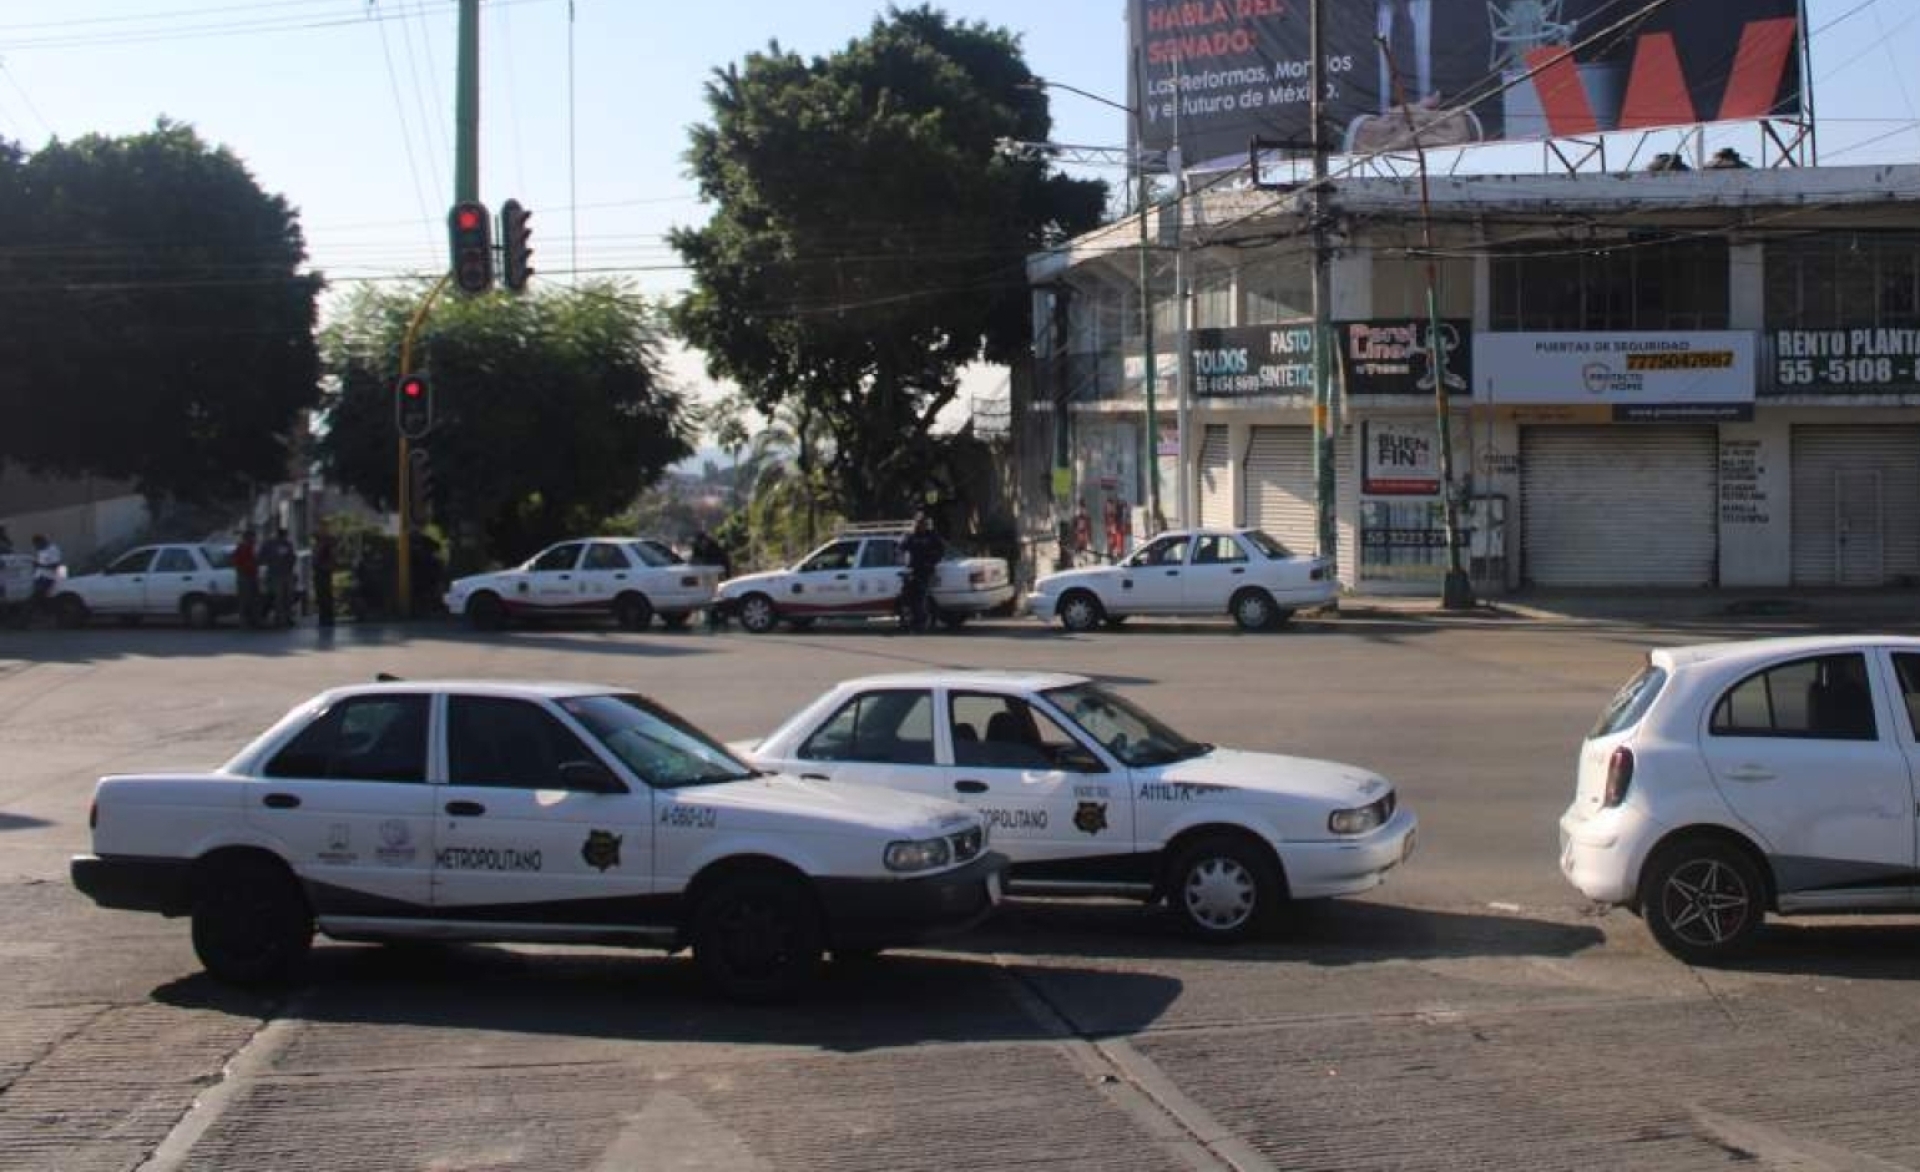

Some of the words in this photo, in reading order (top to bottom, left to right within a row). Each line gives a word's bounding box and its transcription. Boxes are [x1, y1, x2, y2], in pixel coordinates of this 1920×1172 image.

[1148, 2, 1229, 31] HABLA
[1237, 0, 1285, 18] DEL
[1148, 78, 1176, 96] Las
[1180, 65, 1270, 93] Reformas,
[1275, 55, 1354, 78] Morlos
[1148, 103, 1158, 123] y
[1183, 95, 1236, 116] futuro
[1239, 89, 1264, 110] de
[1268, 81, 1340, 105] Méxio.
[1270, 329, 1311, 355] PASTO
[1535, 341, 1590, 352] PUERTAS
[1595, 341, 1611, 351] DE
[1613, 340, 1691, 351] SEGURIDAD
[1778, 329, 1846, 357] RENTO
[1192, 347, 1248, 375] TOLDOS
[1779, 359, 1813, 385] 55
[1378, 433, 1430, 451] BUEN
[1378, 448, 1417, 466] FIN
[434, 847, 542, 871] METROPOLITANO
